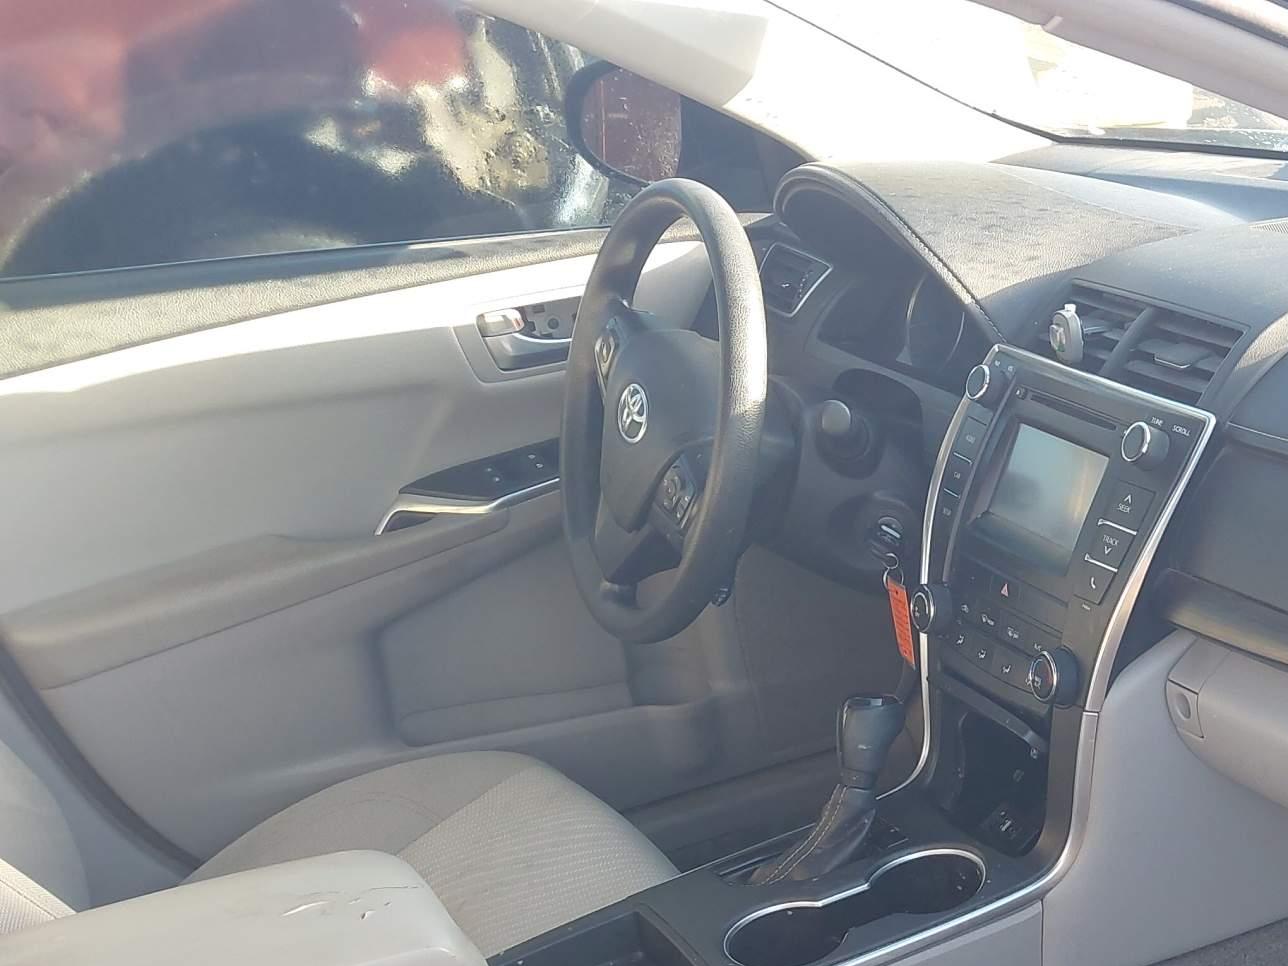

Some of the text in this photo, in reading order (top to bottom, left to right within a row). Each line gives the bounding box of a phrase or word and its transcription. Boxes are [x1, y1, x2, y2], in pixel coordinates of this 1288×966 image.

[1172, 424, 1191, 437] SCROLL
[1118, 503, 1131, 513] SEEK
[1103, 534, 1119, 546] TRACK
